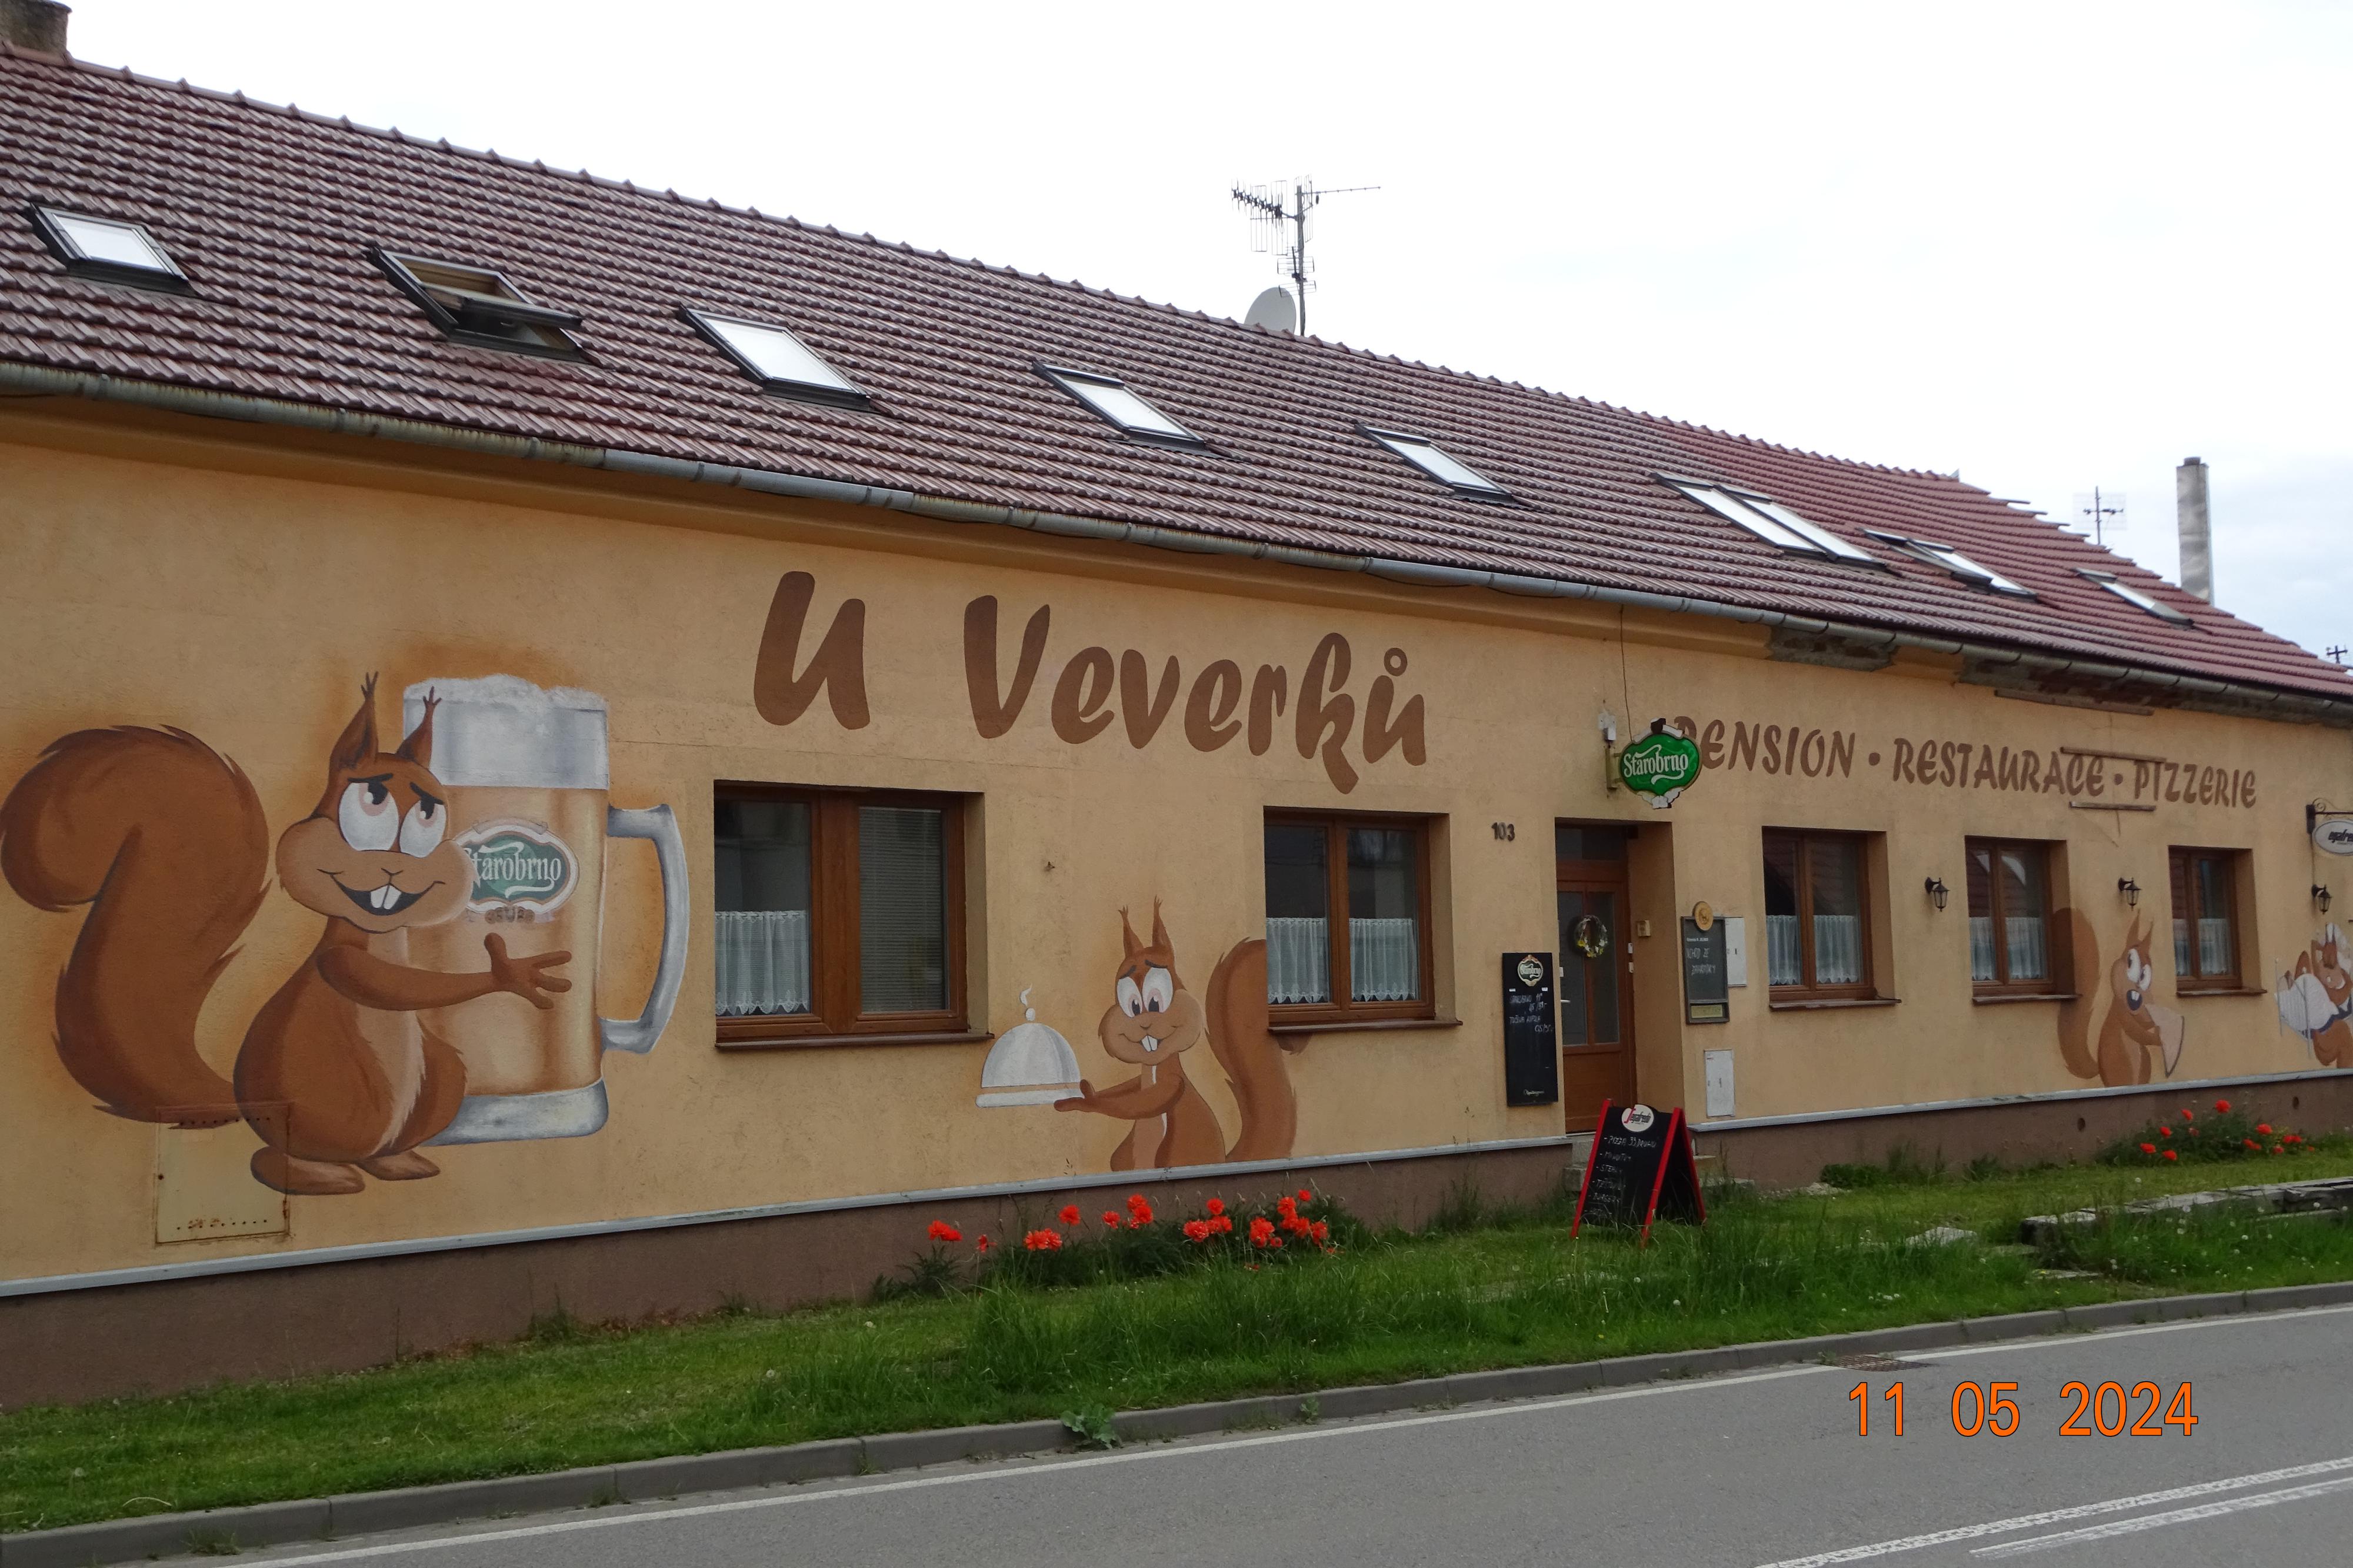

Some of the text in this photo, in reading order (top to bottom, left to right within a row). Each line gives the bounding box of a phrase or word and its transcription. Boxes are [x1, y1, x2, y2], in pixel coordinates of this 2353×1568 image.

[754, 571, 1427, 794] U Veverků
[1623, 744, 1688, 785] Starobrno
[1893, 738, 2105, 796] RESTAURACE
[2134, 760, 2257, 809] PIZZERIE
[1491, 822, 1515, 842] 103
[464, 842, 562, 899] tarobrno
